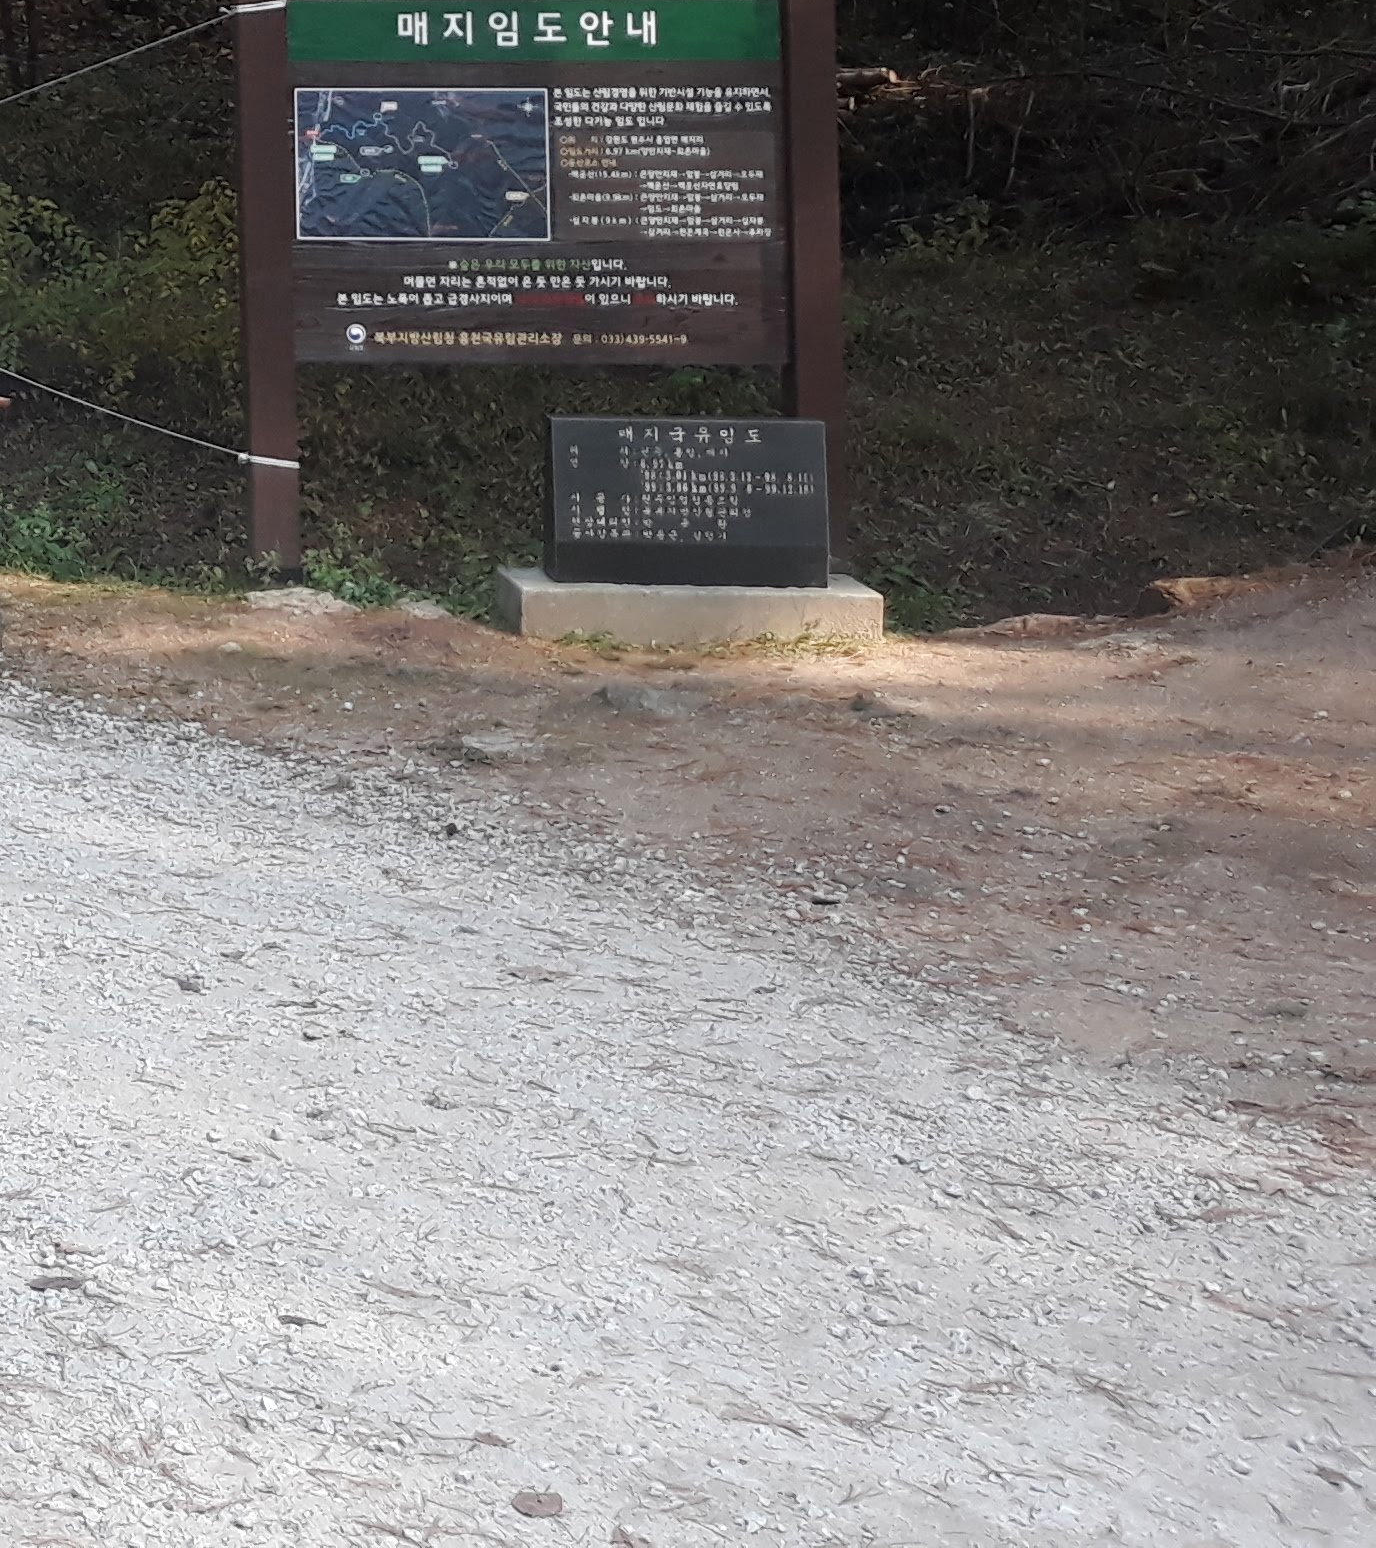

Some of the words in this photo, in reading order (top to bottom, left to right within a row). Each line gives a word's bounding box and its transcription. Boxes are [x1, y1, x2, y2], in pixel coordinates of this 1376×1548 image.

[439, 276, 472, 288] 자리는
[589, 276, 622, 288] 가시기
[624, 276, 671, 288] 바랍니다.
[336, 293, 348, 305] 본
[351, 293, 384, 305] 임도는
[598, 293, 631, 305] 있으니
[656, 293, 688, 305] 하시기
[691, 293, 739, 305] 바랍니다.
[374, 332, 455, 345] 북부지방산림청
